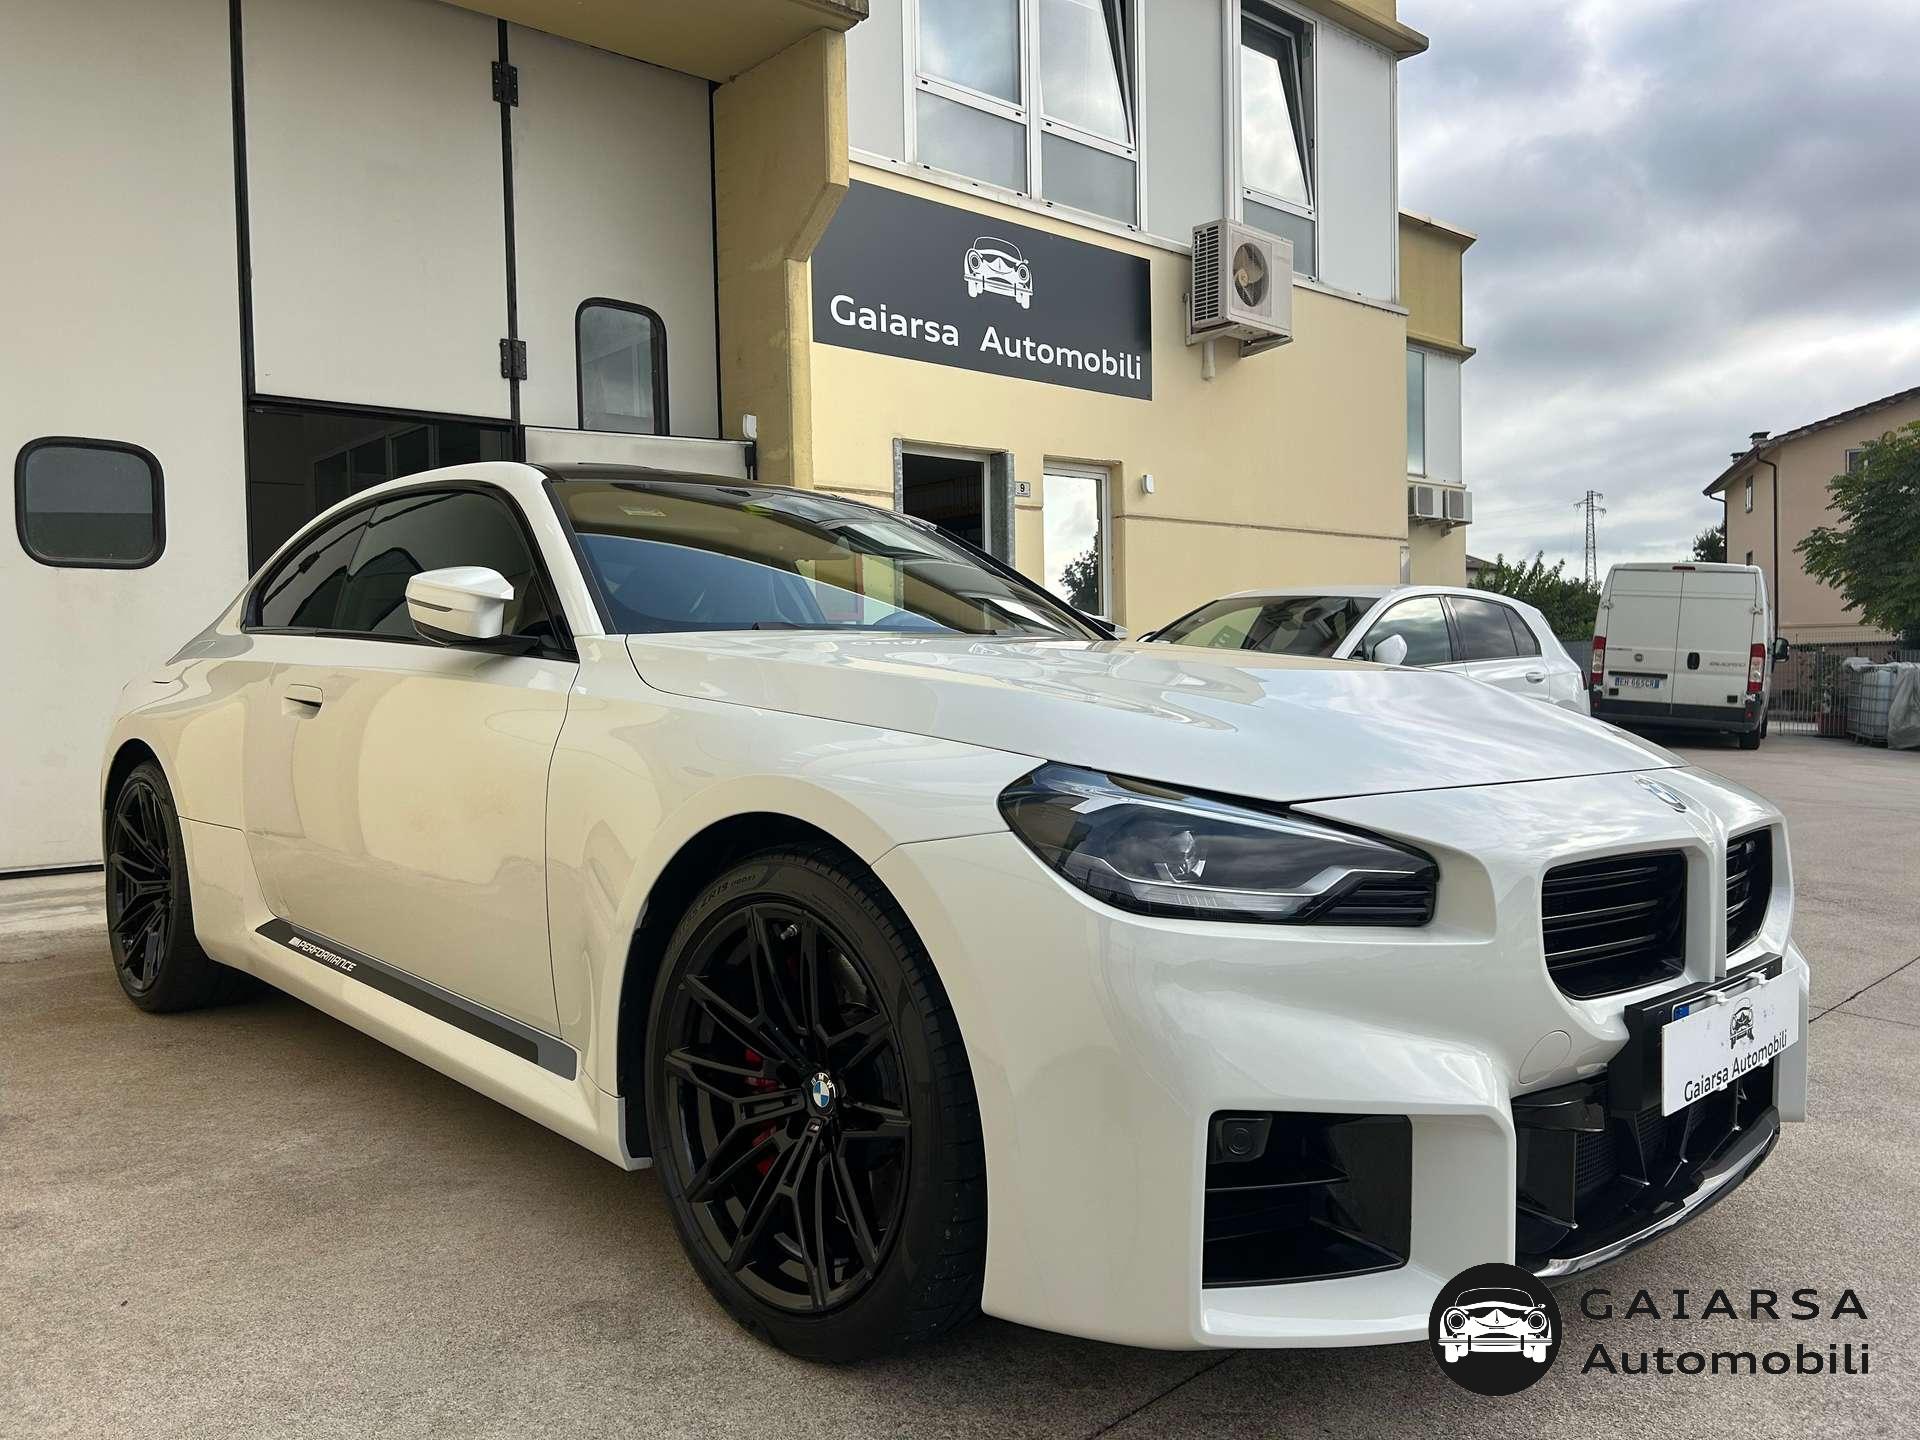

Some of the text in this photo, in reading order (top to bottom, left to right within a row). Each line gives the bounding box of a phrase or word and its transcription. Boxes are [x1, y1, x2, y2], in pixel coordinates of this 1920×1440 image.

[830, 294, 1141, 380] Gaiarsa Automobili
[1019, 483, 1026, 493] 9
[298, 941, 357, 972] PERFORMANCE
[1684, 1029, 1788, 1102] Gaiarsa Automobili
